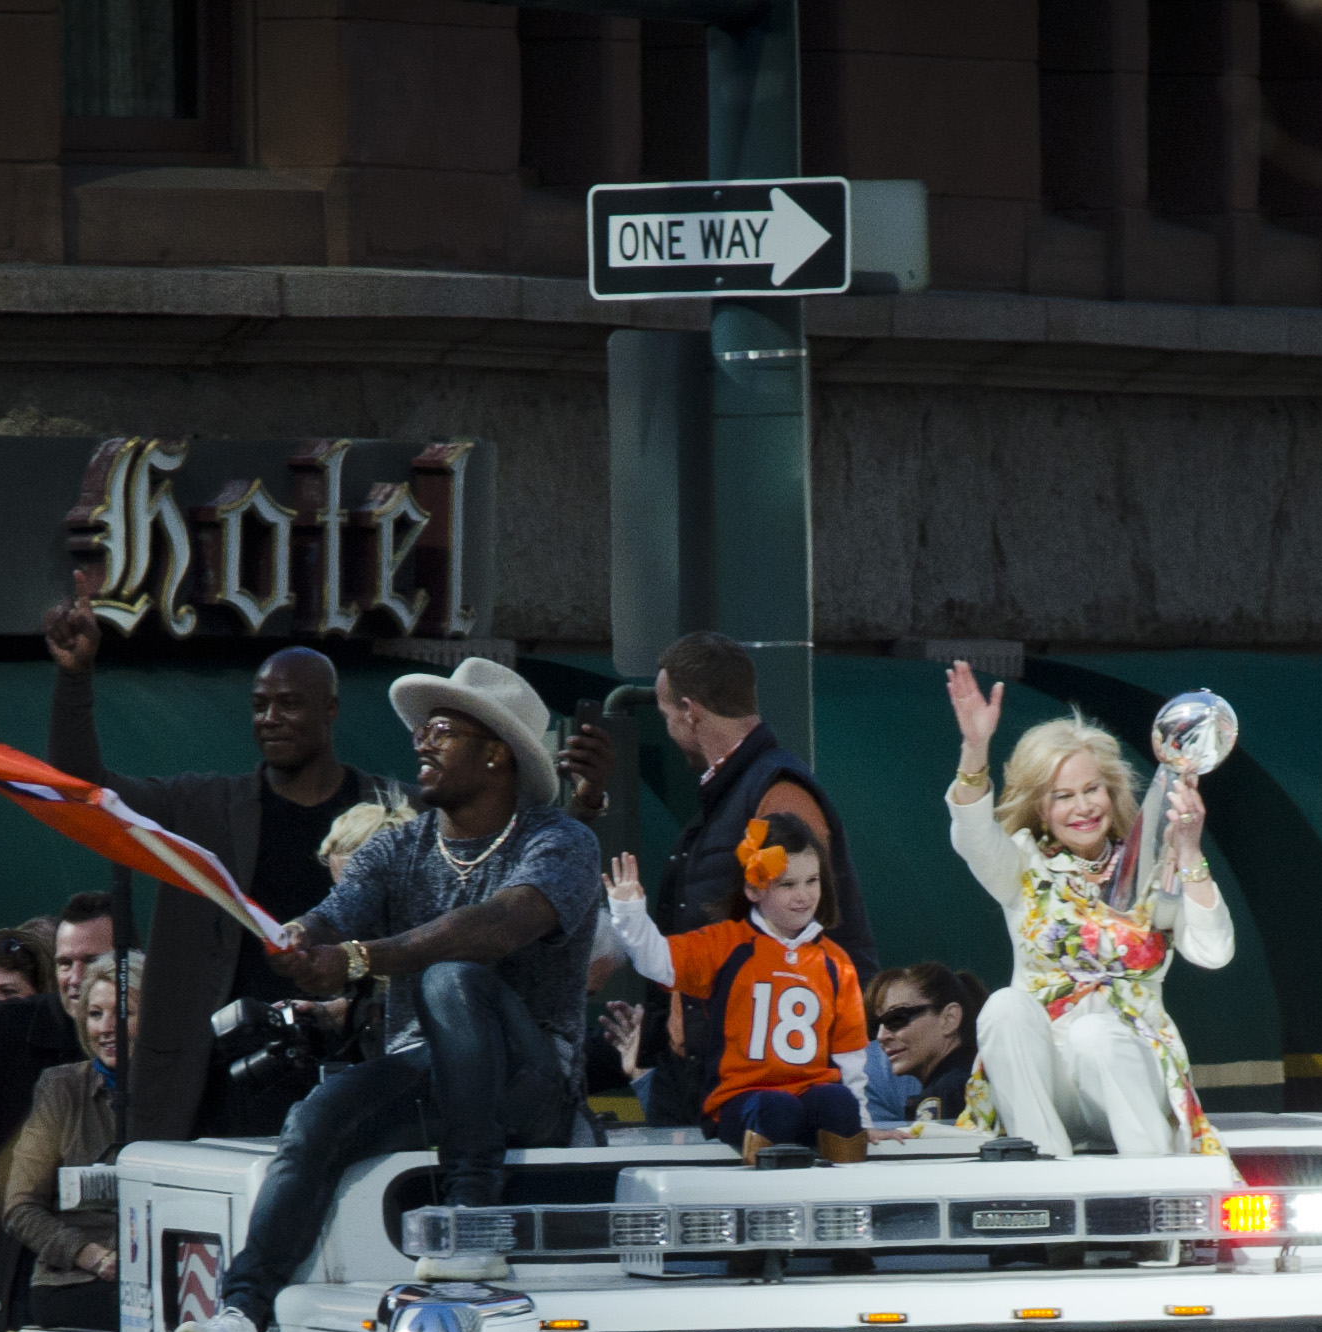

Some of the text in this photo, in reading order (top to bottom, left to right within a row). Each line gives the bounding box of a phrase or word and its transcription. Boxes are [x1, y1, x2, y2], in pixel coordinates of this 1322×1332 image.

[619, 218, 768, 261] ONE WAY
[747, 981, 822, 1066] 18
